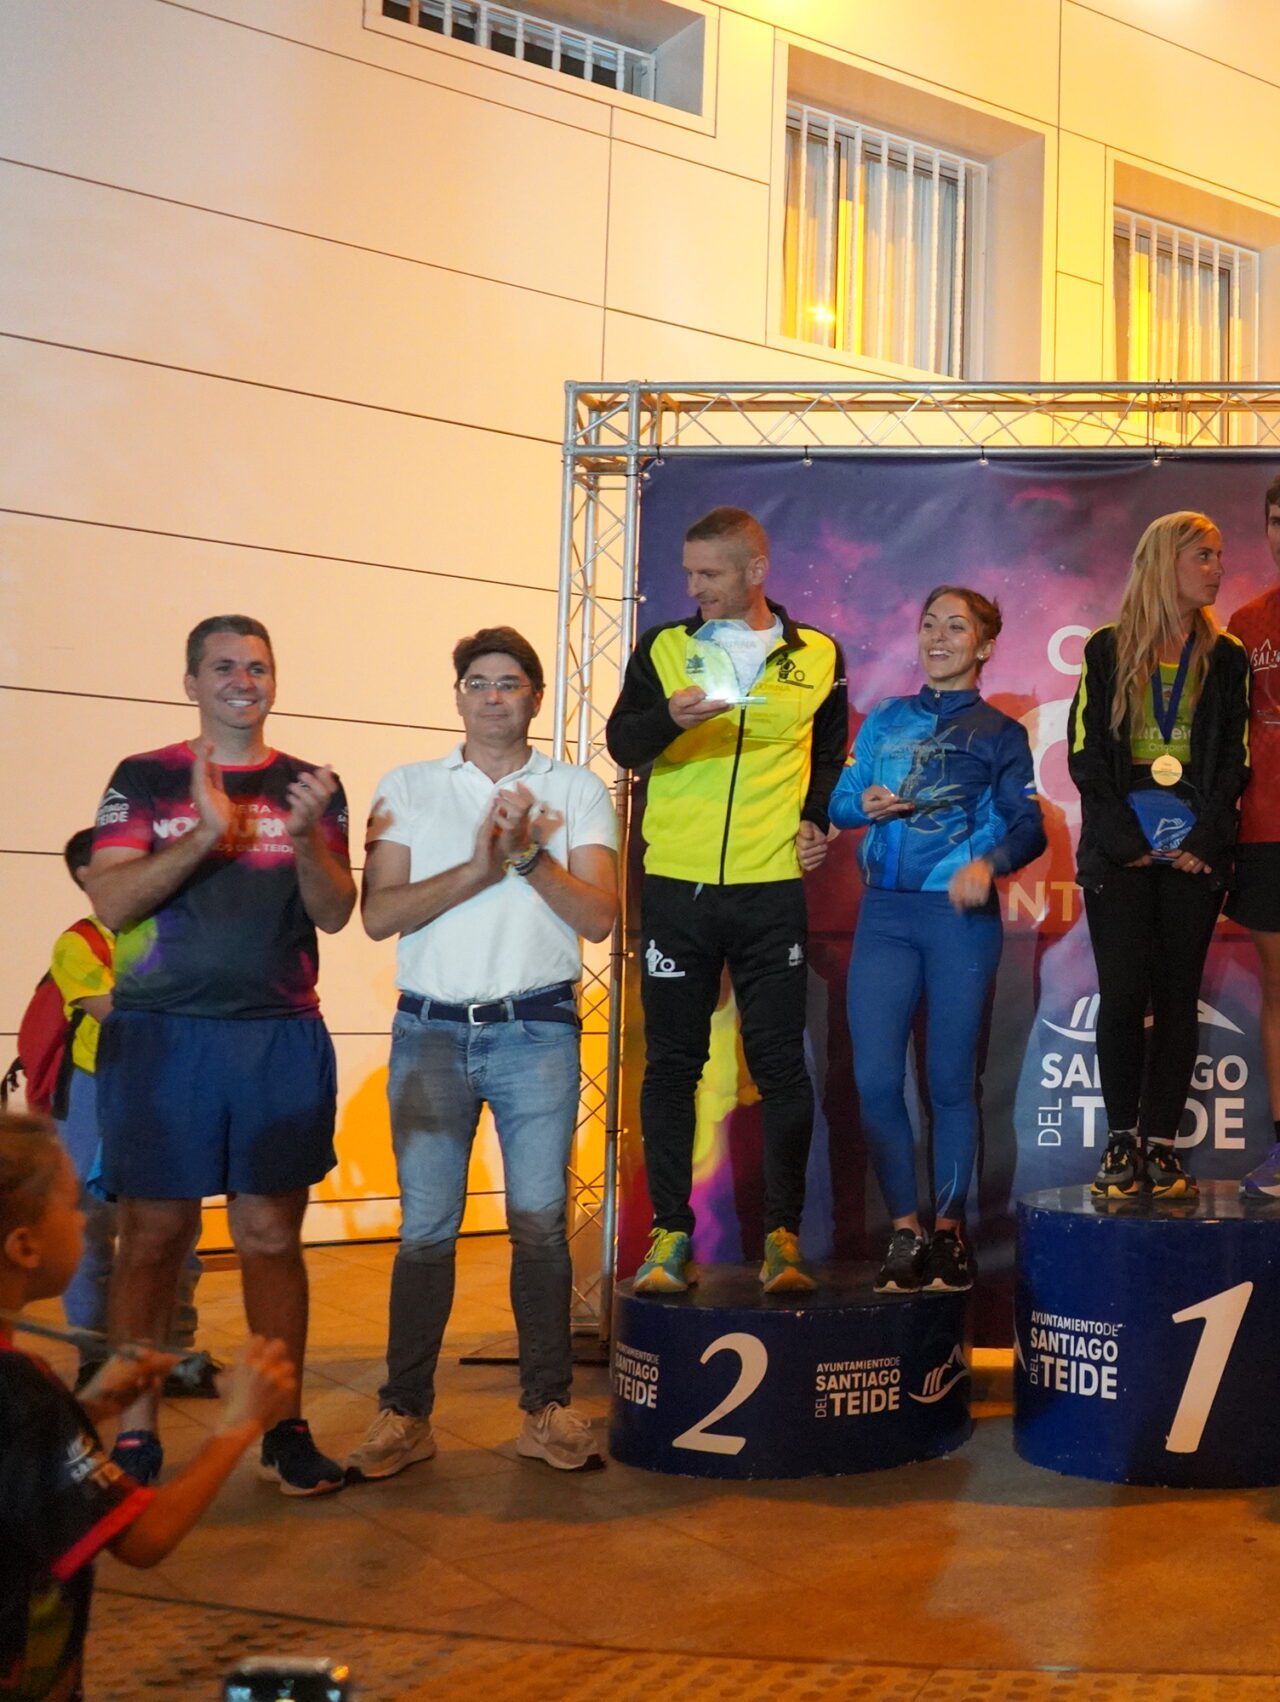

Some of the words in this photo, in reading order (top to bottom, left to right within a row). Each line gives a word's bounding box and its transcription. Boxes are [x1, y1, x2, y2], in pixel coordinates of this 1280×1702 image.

[1040, 1052, 1249, 1091] SAGO
[1037, 1098, 1062, 1147] DEL
[1071, 1096, 1246, 1150] TDE
[1030, 1327, 1119, 1363] SANTIAGO
[815, 1368, 900, 1392] SANTIAGO
[1030, 1355, 1039, 1385] DEL
[1039, 1356, 1118, 1400] TEIDE
[1165, 1280, 1254, 1454] 1
[617, 1373, 658, 1409] TEIDE
[672, 1332, 769, 1455] 2
[815, 1394, 828, 1418] DEL
[829, 1386, 900, 1417] TEIDE
